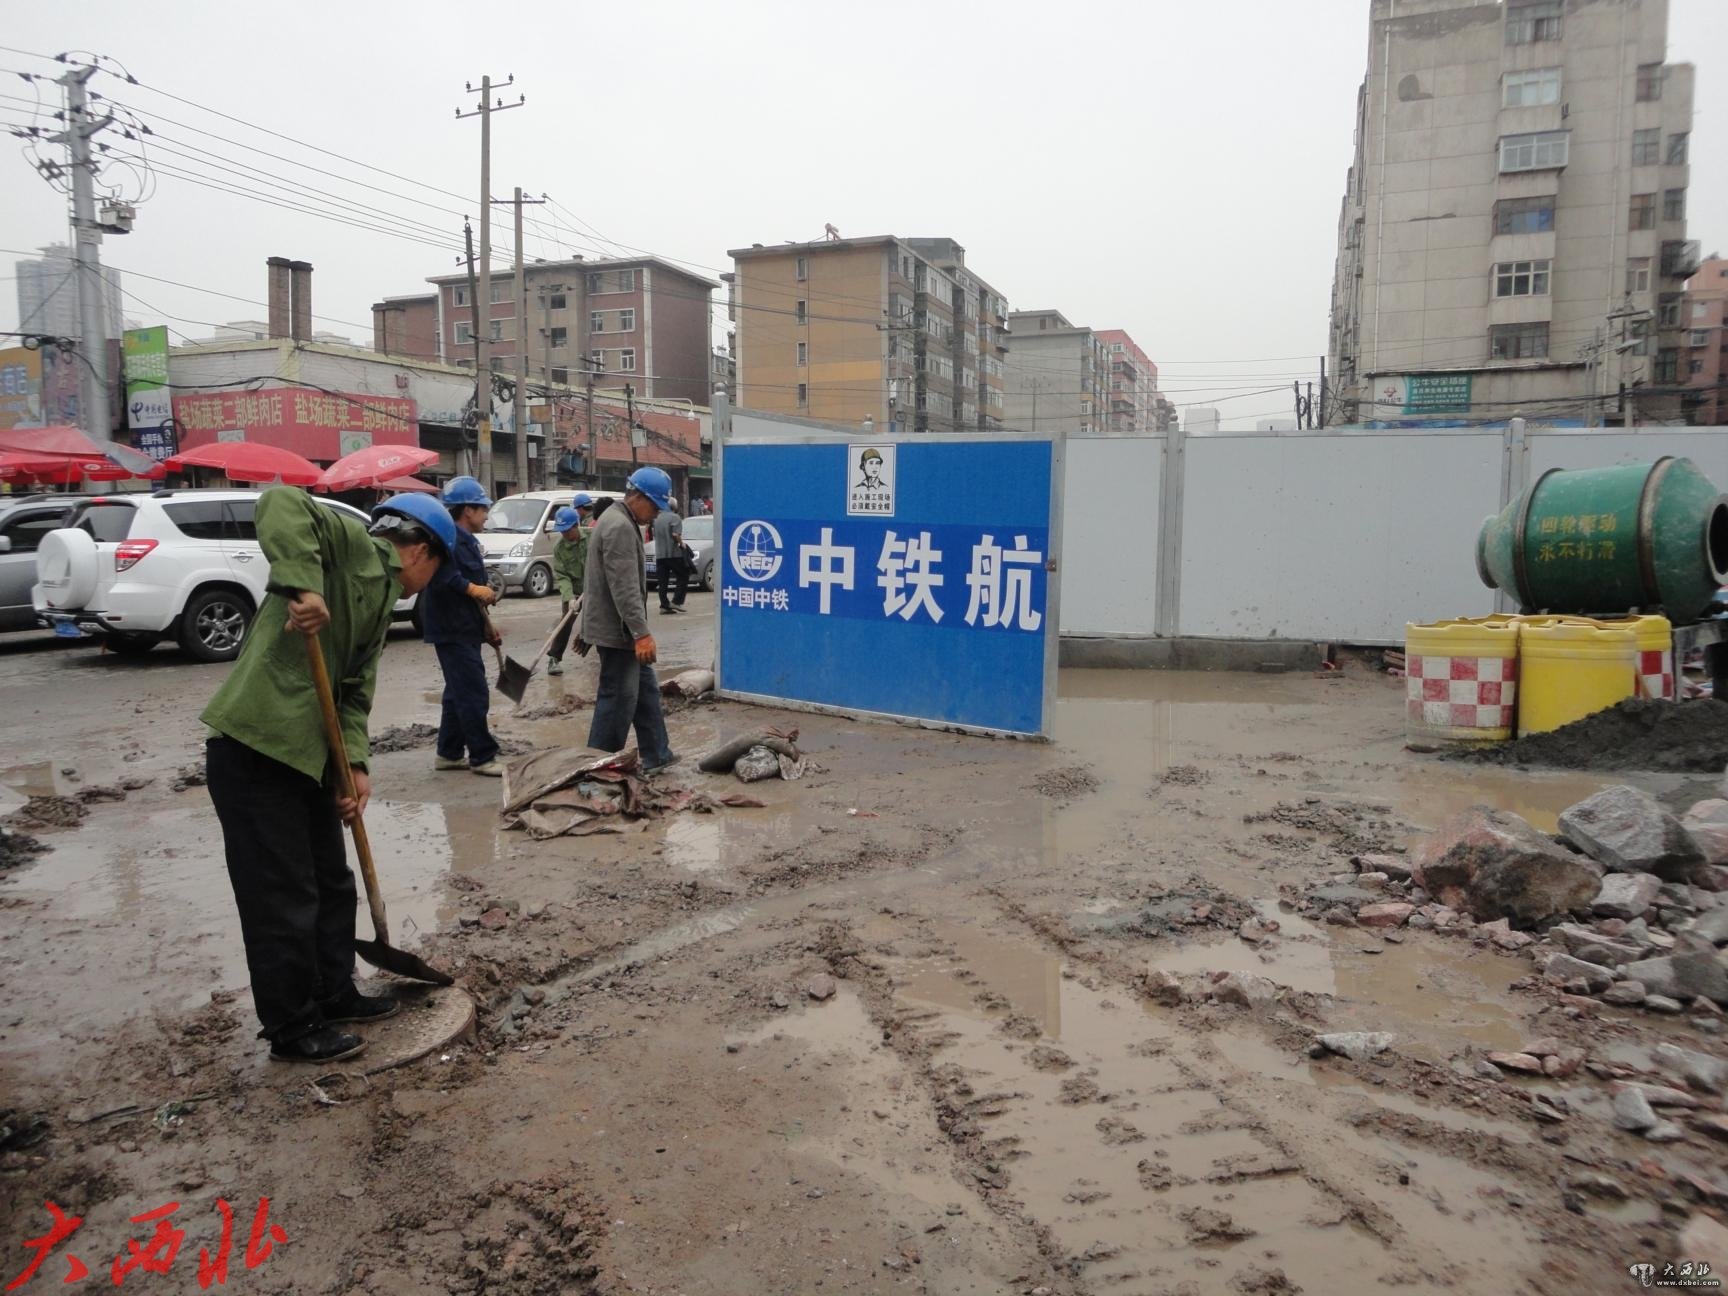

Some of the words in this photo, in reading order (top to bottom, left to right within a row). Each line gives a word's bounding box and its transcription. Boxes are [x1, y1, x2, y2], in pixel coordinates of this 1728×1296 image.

[722, 585, 790, 611] 中国中铁
[799, 527, 1043, 631] 中铁航
